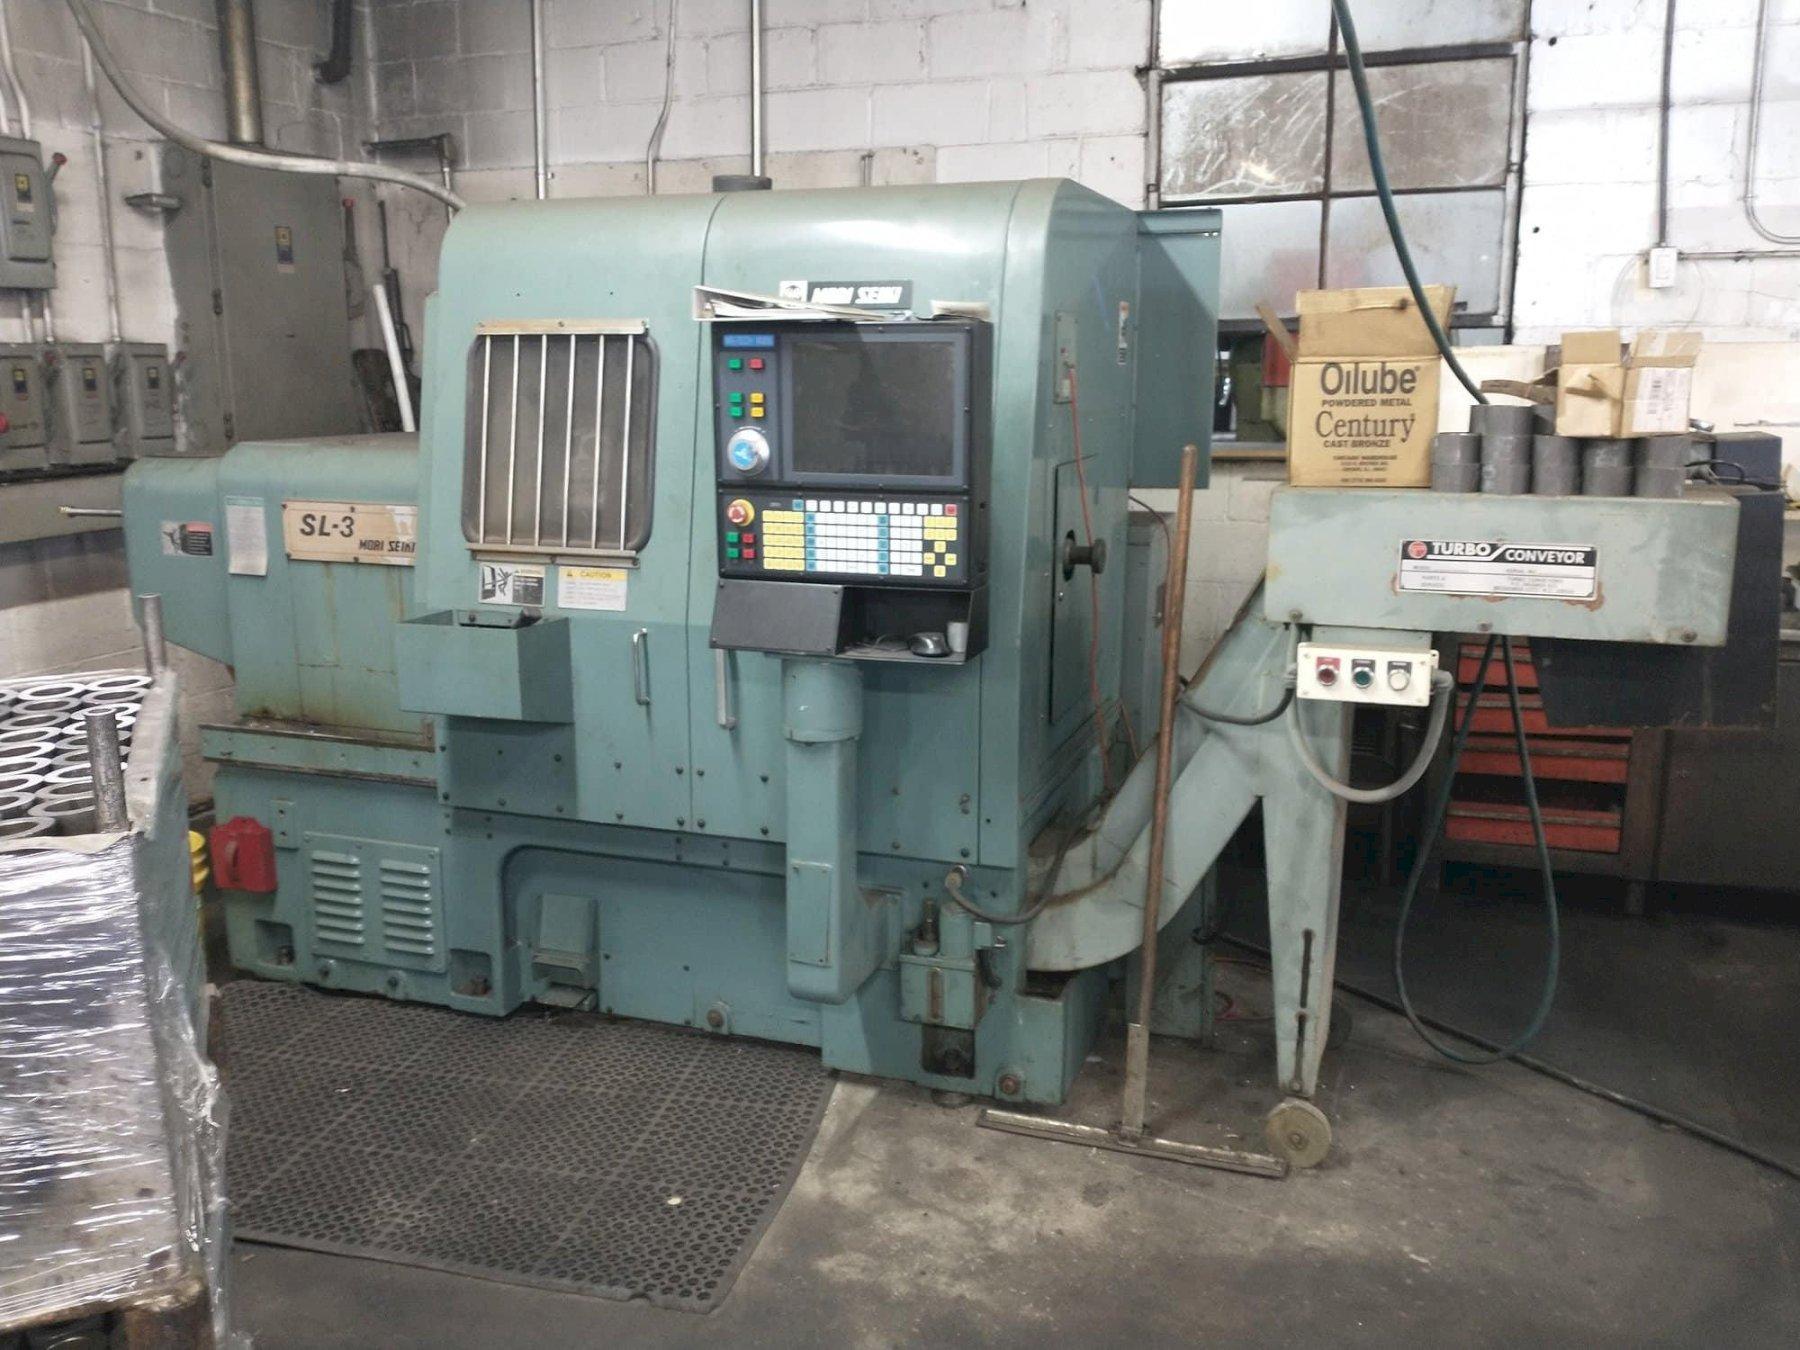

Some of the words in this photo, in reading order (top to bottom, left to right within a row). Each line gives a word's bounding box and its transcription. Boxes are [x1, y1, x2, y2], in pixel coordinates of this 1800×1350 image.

[1320, 362, 1417, 395] Oilube
[1321, 398, 1377, 407] POWDERED
[1379, 398, 1412, 406] METAL
[1315, 410, 1415, 443] Century
[1323, 440, 1348, 448] CAST
[1350, 440, 1391, 448] BRONZE
[300, 513, 354, 538] SL-3
[359, 539, 384, 551] MORI
[1432, 542, 1491, 556] TURBO
[1505, 549, 1585, 564] CONVEYOR
